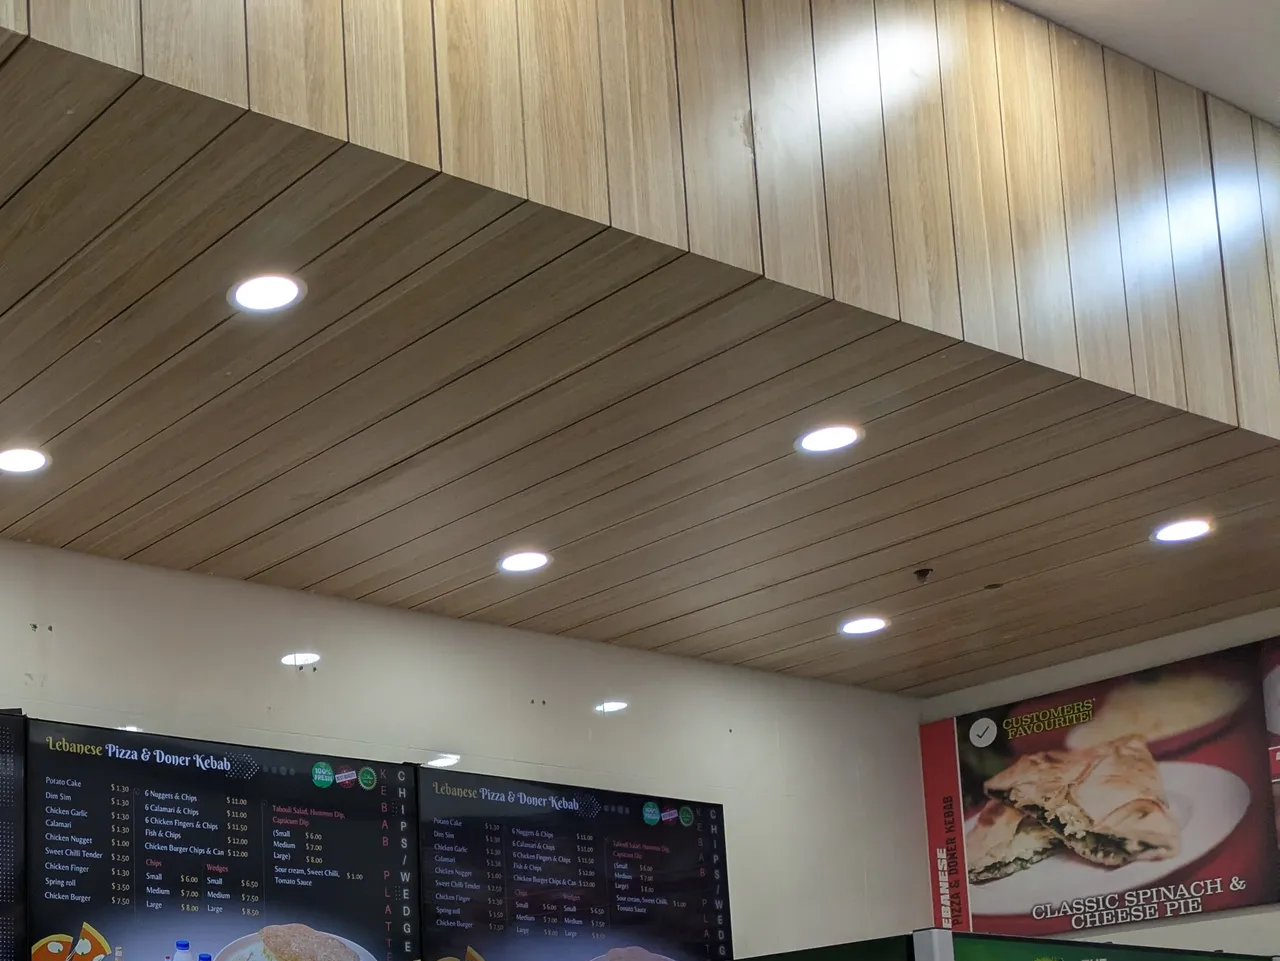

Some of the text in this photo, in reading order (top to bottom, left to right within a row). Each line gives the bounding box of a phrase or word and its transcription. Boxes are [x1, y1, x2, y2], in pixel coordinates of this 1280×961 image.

[1007, 710, 1093, 740] FAVOURITE!
[46, 737, 231, 771] Lebanese Pizza & Doner Kebab
[46, 777, 81, 787] Potato Cake
[433, 782, 579, 811] Lebanese Pizza & Doner Kebab
[380, 769, 389, 846] KEBAB
[943, 796, 954, 833] KEBAB
[46, 819, 71, 828] Calamari
[146, 859, 162, 867] Chips
[207, 864, 228, 872] Wedges
[946, 836, 958, 875] DONER
[146, 887, 170, 895] Medium
[275, 877, 295, 885] Tomato
[937, 848, 952, 929] EBANESE
[949, 895, 962, 926] PIZZA
[1031, 876, 1246, 921] CLASSIC SPINACH &
[1071, 898, 1203, 929] CHEESE PIE
